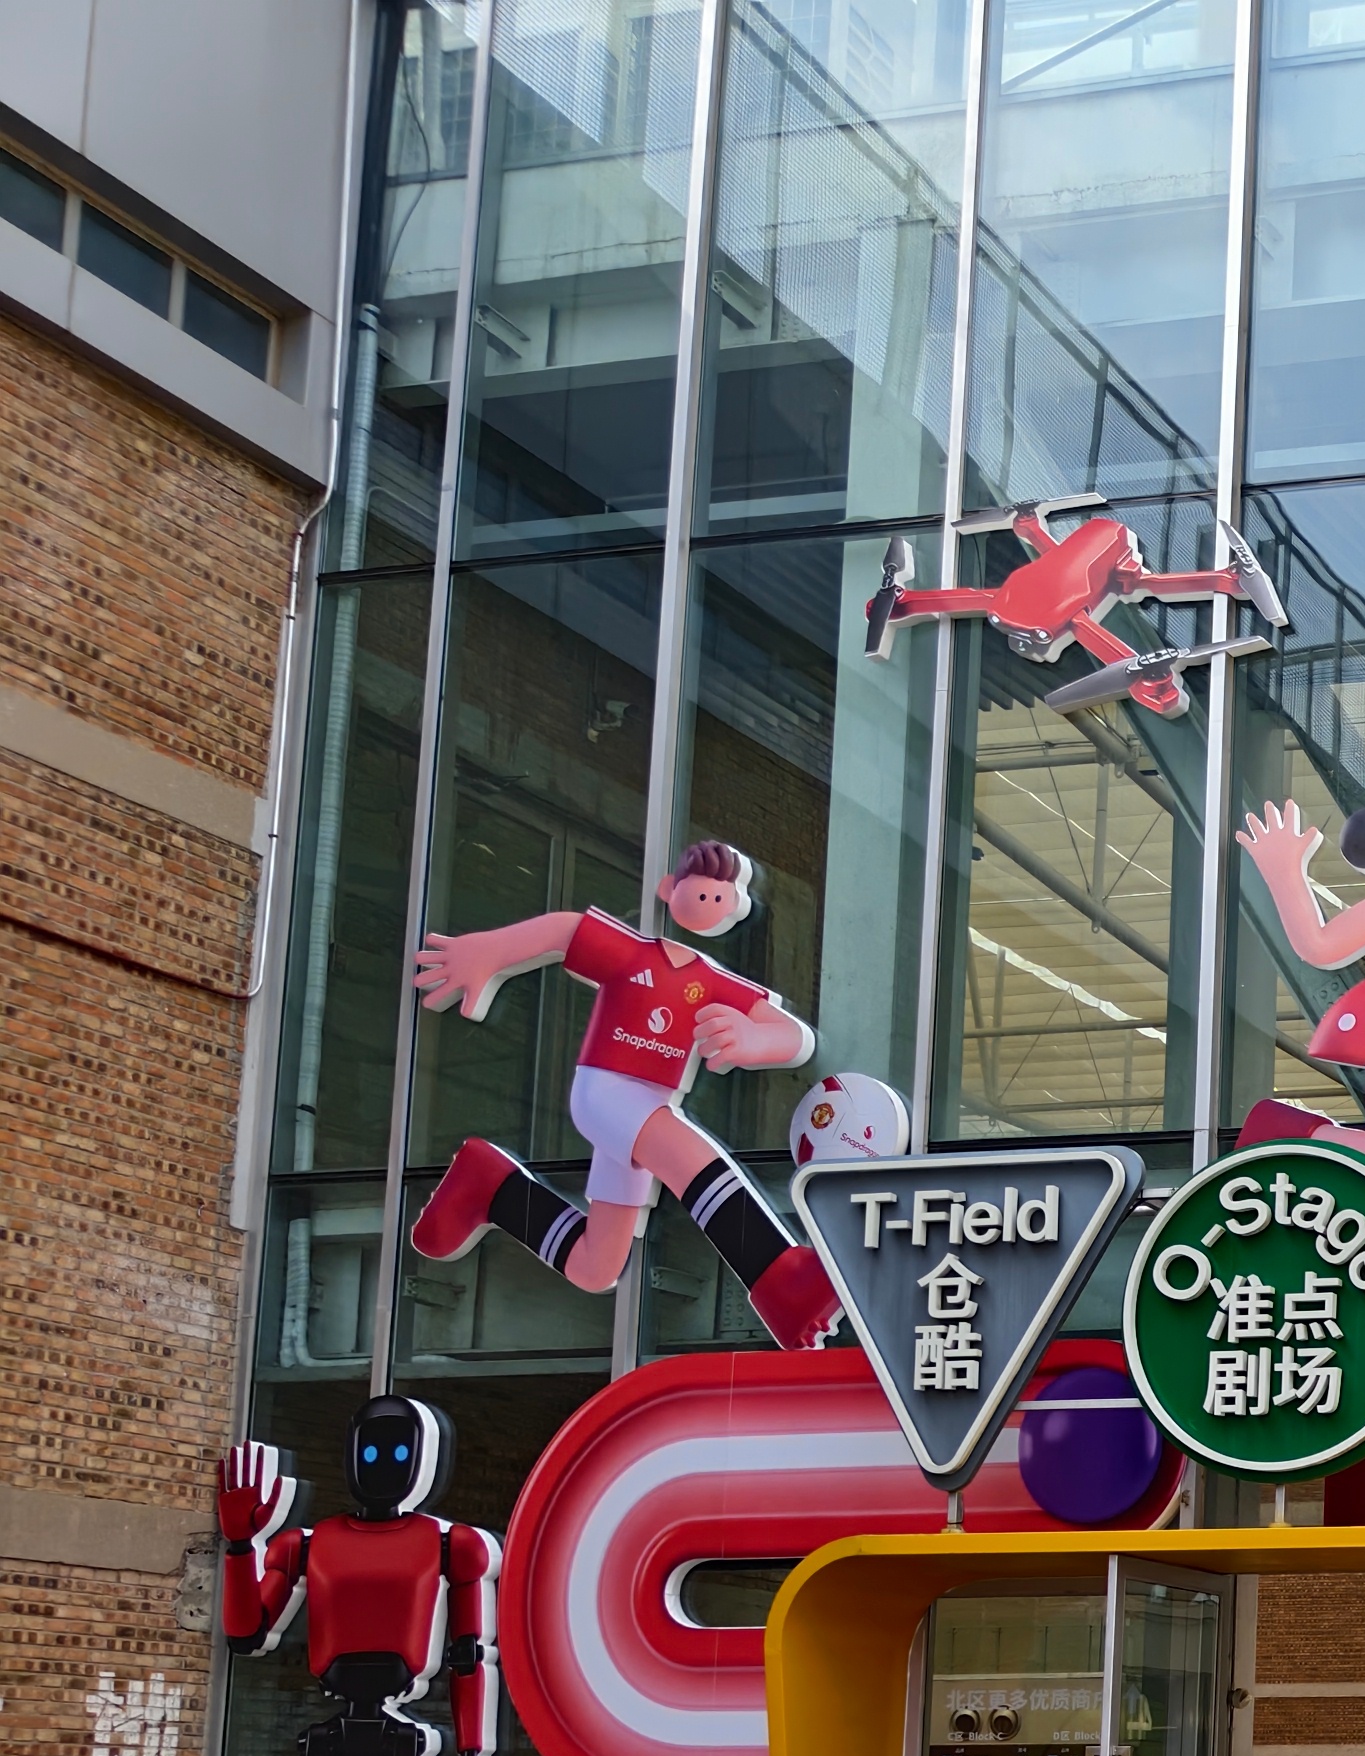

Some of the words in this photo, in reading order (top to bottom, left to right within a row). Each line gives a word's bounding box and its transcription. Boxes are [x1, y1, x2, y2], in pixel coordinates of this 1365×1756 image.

[612, 1026, 686, 1061] Snapdragon
[850, 1184, 1060, 1250] T-Field
[1207, 1270, 1344, 1344] 准点
[1202, 1345, 1343, 1416] 剧场
